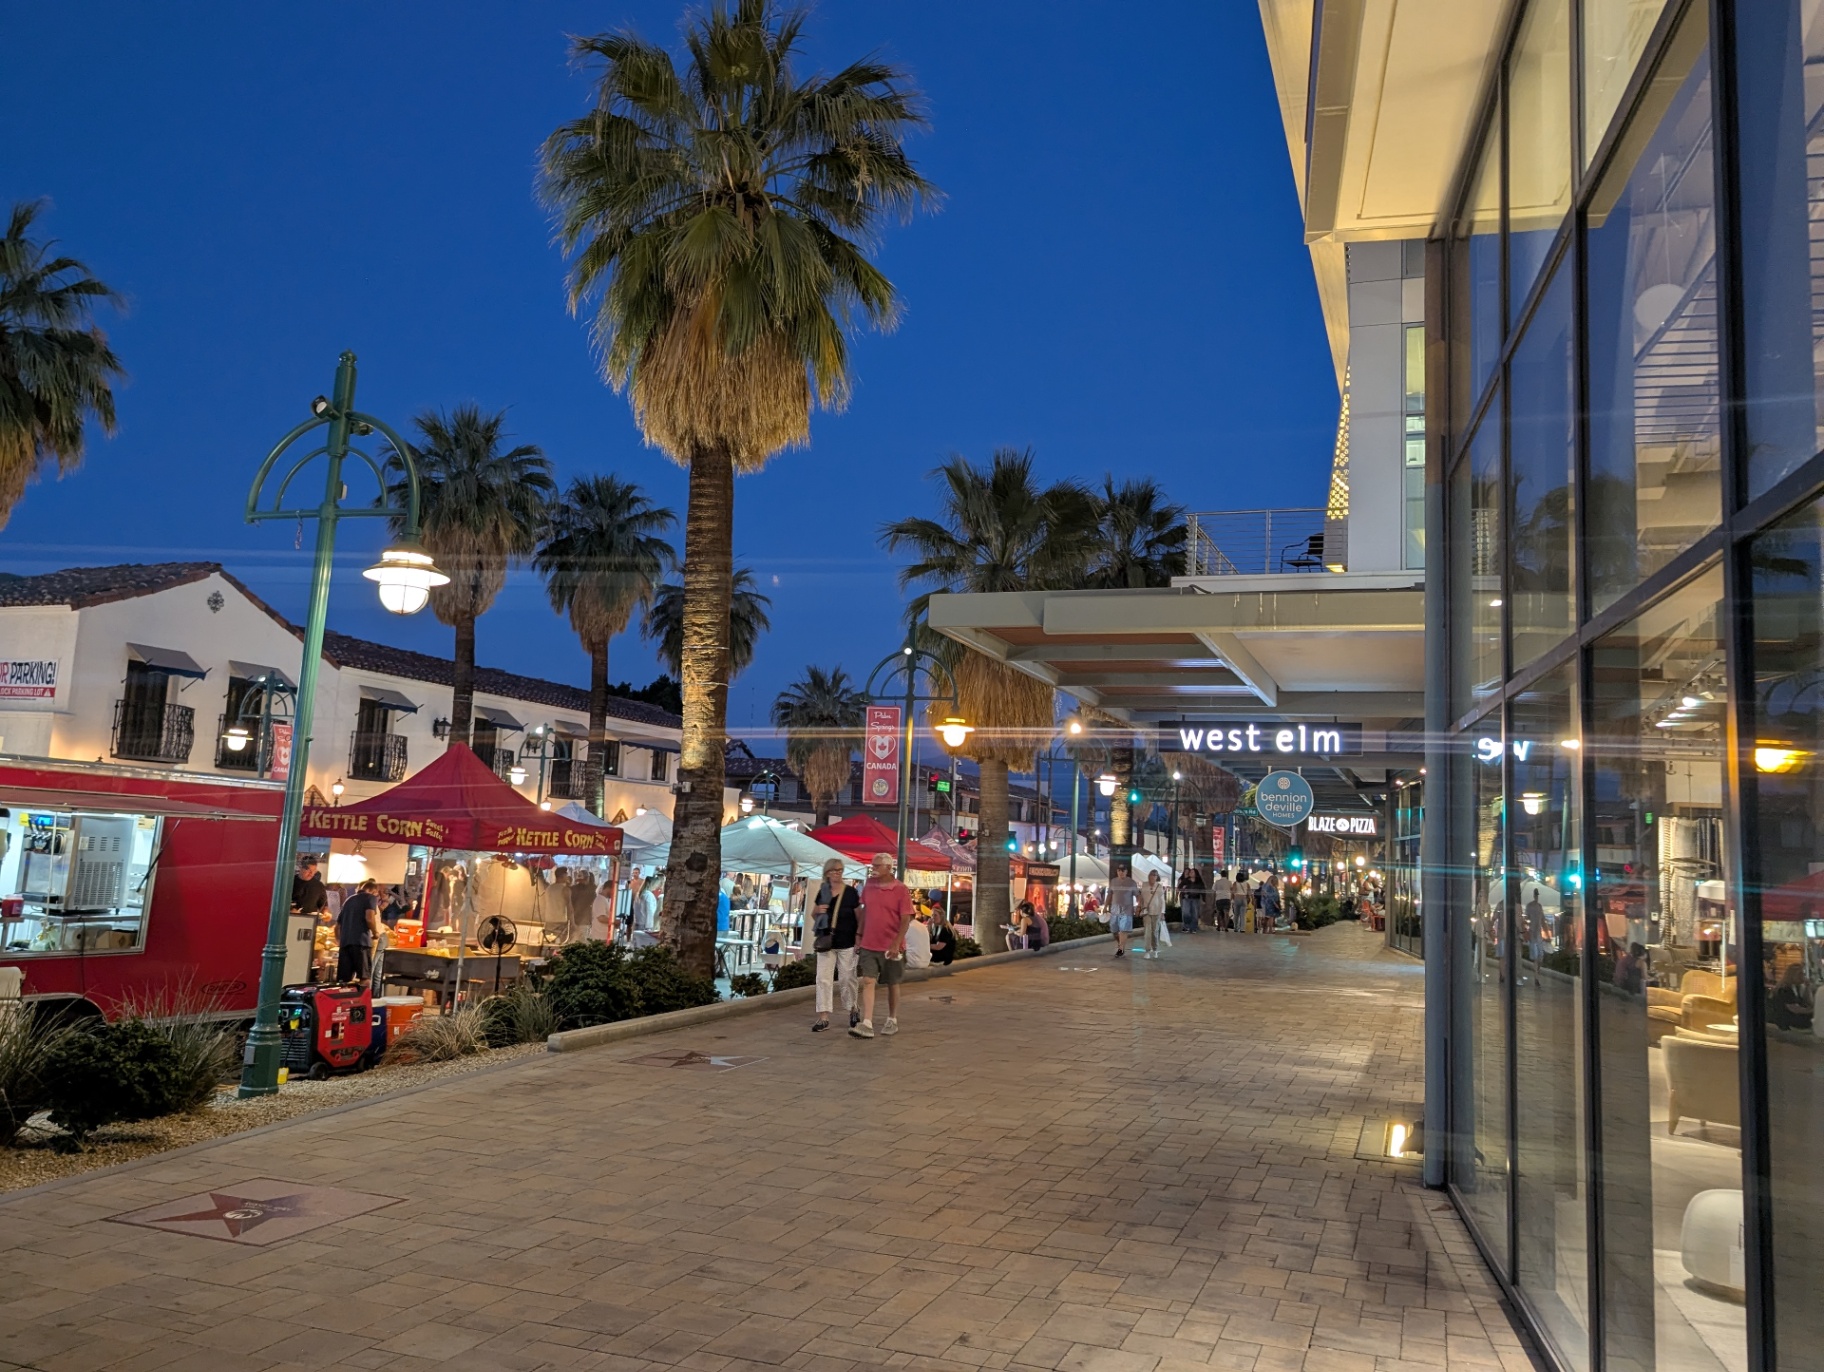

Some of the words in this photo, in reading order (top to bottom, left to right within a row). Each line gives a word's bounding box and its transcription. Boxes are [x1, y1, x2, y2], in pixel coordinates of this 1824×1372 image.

[9, 661, 57, 685] PARKING!
[34, 688, 44, 696] LOT
[870, 721, 895, 733] Springs
[1179, 723, 1261, 751] west
[1275, 724, 1340, 753] elm
[866, 762, 897, 770] CANADA
[1261, 791, 1307, 803] bennion
[1265, 802, 1303, 812] deville
[309, 810, 368, 831] KETTLE
[376, 814, 423, 838] CORN
[1307, 816, 1336, 832] BLAZE
[1350, 817, 1376, 834] PIZZA
[425, 828, 444, 842] Salty
[516, 827, 560, 847] KETTLE
[564, 829, 594, 850] CORN
